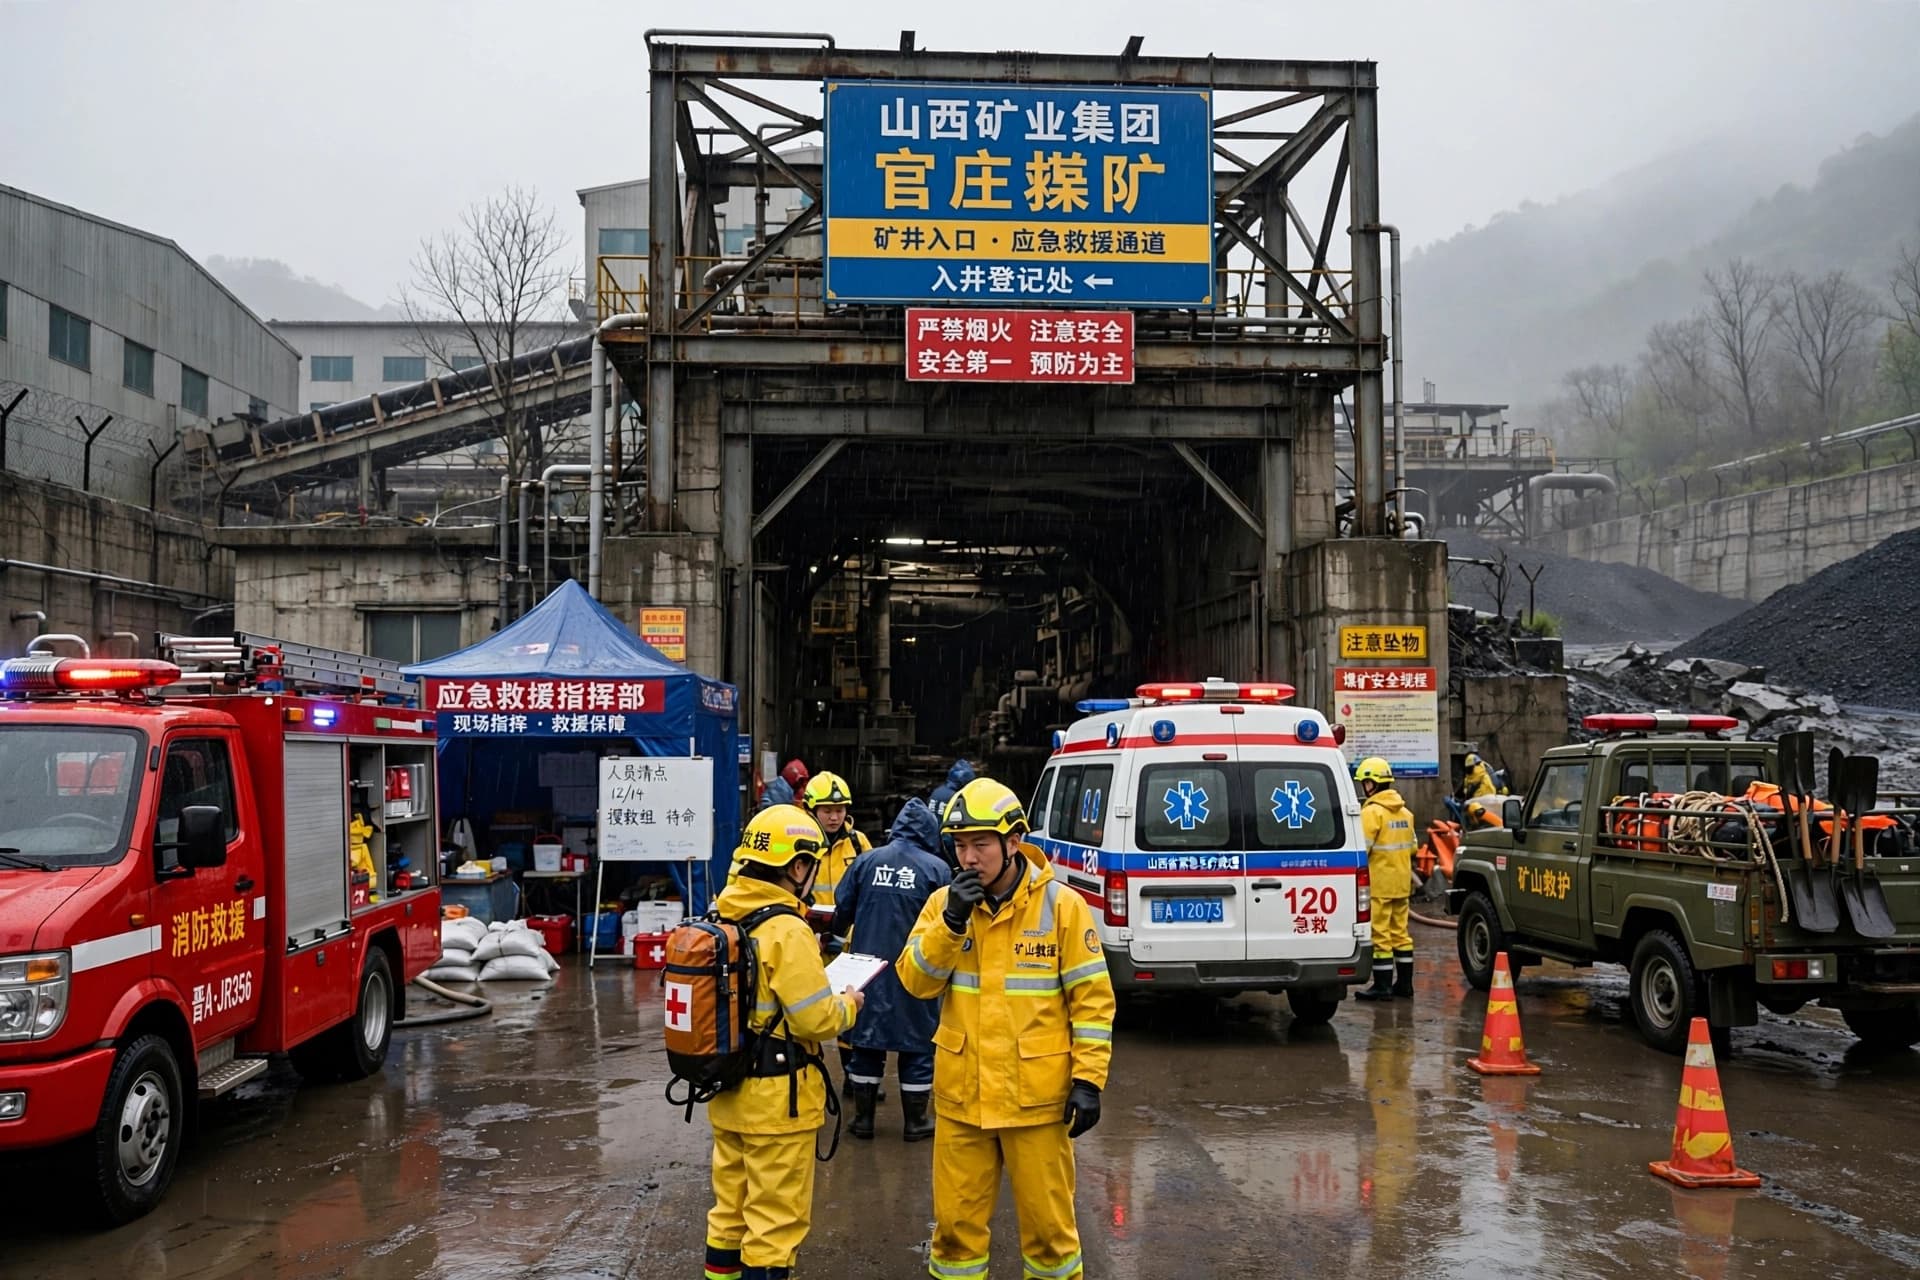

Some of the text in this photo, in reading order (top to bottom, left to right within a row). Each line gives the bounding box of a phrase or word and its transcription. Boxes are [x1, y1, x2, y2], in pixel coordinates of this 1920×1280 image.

[880, 97, 1160, 145] 山西矿业集团
[873, 226, 1166, 255] 矿井入口 应急救援通道
[931, 266, 1074, 294] 入井登记处
[917, 317, 1125, 344] 严禁烟火 注意安全
[917, 349, 1125, 376] 安全第一 预防为主
[1346, 632, 1420, 653] 注意坠物
[436, 681, 646, 711] 应急救援指挥部
[453, 714, 626, 733] 现场指挥 救援保障
[607, 763, 668, 783] 人员清点
[611, 784, 645, 804] 12/14
[666, 807, 696, 828] 待命
[1082, 849, 1099, 876] 120
[872, 863, 916, 890] 应急
[1517, 866, 1571, 899] 矿山救护
[1284, 886, 1338, 915] 120
[172, 899, 245, 958] 消防救援
[1293, 916, 1329, 934] 急救
